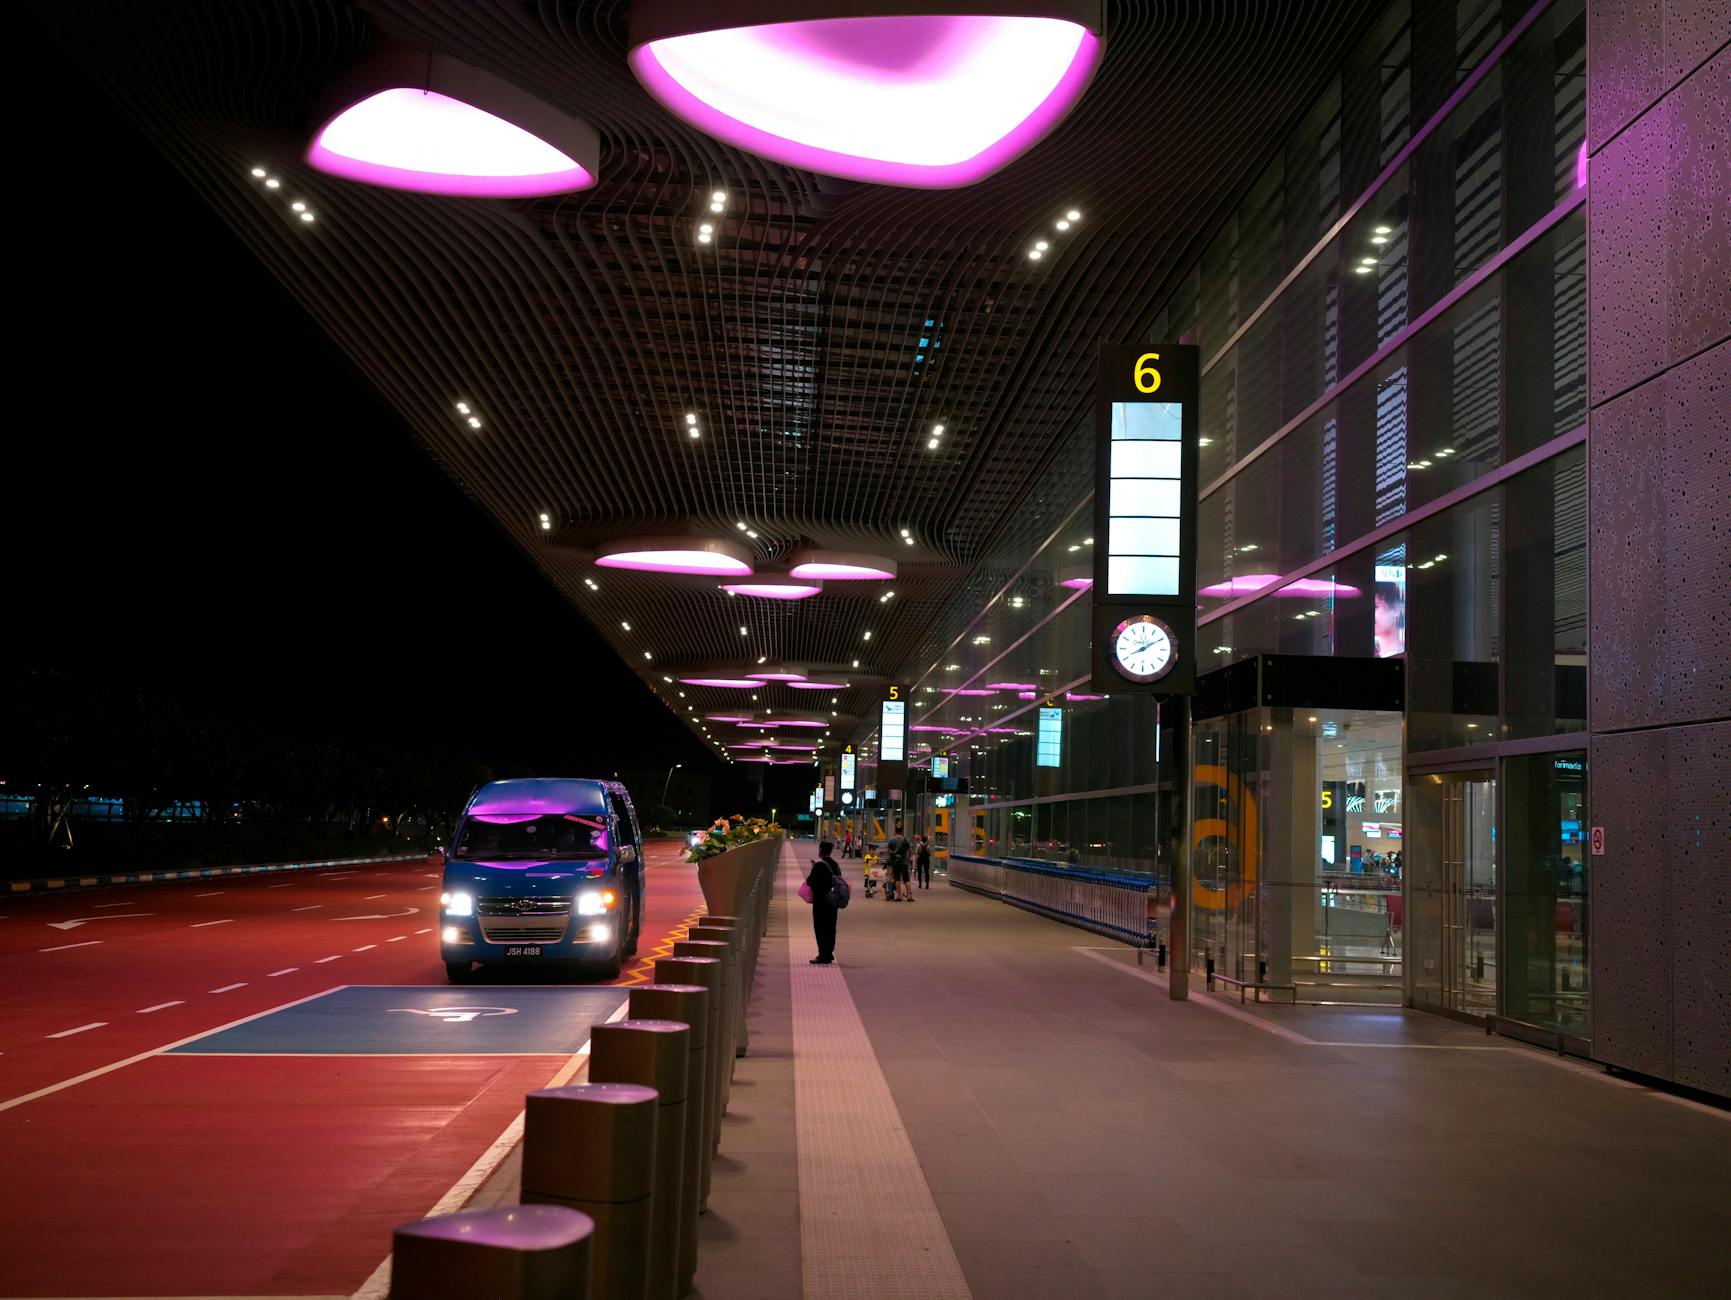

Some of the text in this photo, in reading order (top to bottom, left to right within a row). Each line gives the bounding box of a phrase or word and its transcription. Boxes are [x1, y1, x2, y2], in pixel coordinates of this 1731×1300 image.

[1133, 352, 1162, 394] 6
[889, 686, 899, 700] 5
[844, 744, 853, 754] 4
[1321, 791, 1333, 809] 5
[506, 946, 522, 956] JSH
